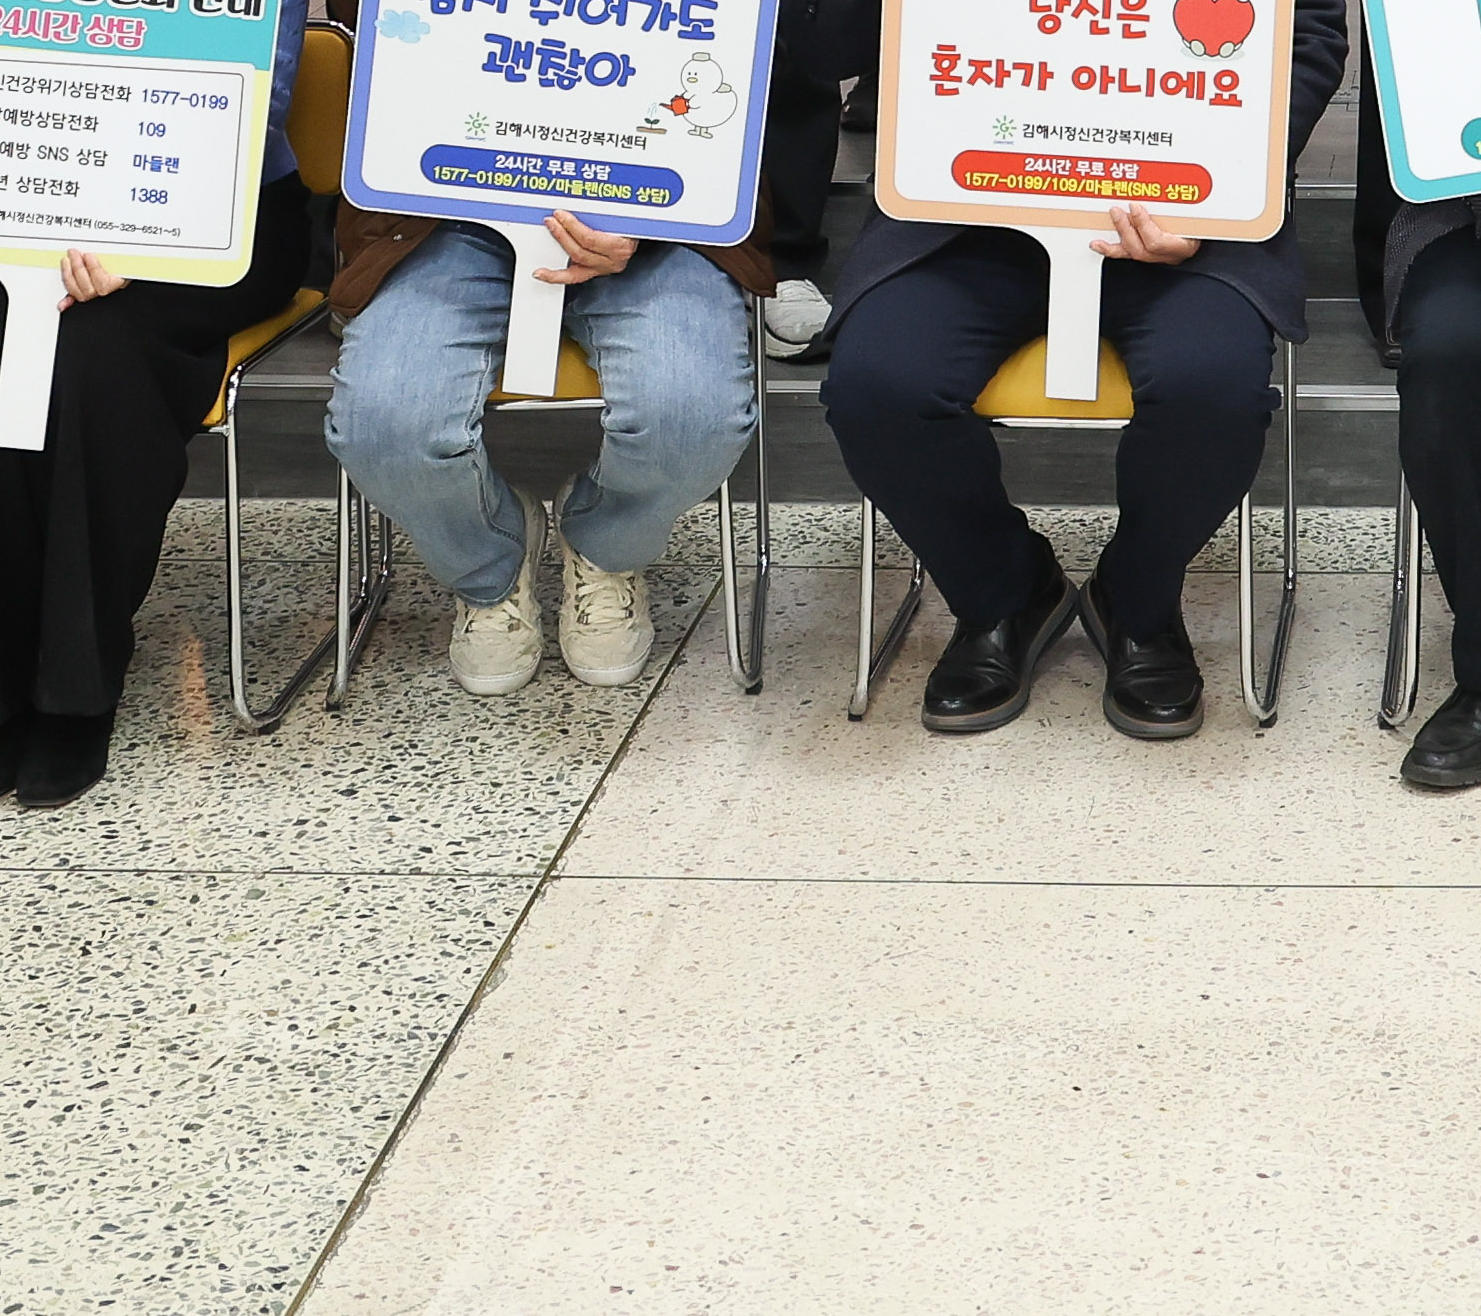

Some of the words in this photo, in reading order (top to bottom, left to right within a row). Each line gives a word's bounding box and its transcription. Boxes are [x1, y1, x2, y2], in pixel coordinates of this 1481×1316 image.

[85, 18, 146, 49] 상담
[481, 32, 637, 90] 괜찮아
[929, 44, 1055, 97] 혼자가
[1071, 65, 1243, 108] 아니에요
[141, 88, 229, 111] 1577-0199
[137, 120, 167, 138] 109
[494, 120, 647, 151] 김해시정신건강복지센터
[1022, 123, 1173, 147] 김해시정신건강복지센터
[37, 145, 69, 162] SNS
[76, 146, 109, 168] 상담
[132, 153, 180, 175] 마들랜
[495, 154, 543, 174] 24시간
[546, 158, 577, 177] 무료
[580, 162, 611, 181] 상담
[1024, 157, 1072, 175] 24시간
[1074, 159, 1104, 176] 무료
[1109, 161, 1139, 179] 상담
[15, 175, 80, 198] 상담전화
[129, 187, 169, 205] 1388
[432, 165, 632, 201] 1577-0199/109/마들랜(SNS
[636, 184, 670, 204] 상담)
[964, 171, 1160, 198] 1577-0199/109/마들랜(SNS
[1165, 182, 1199, 201] 상담)
